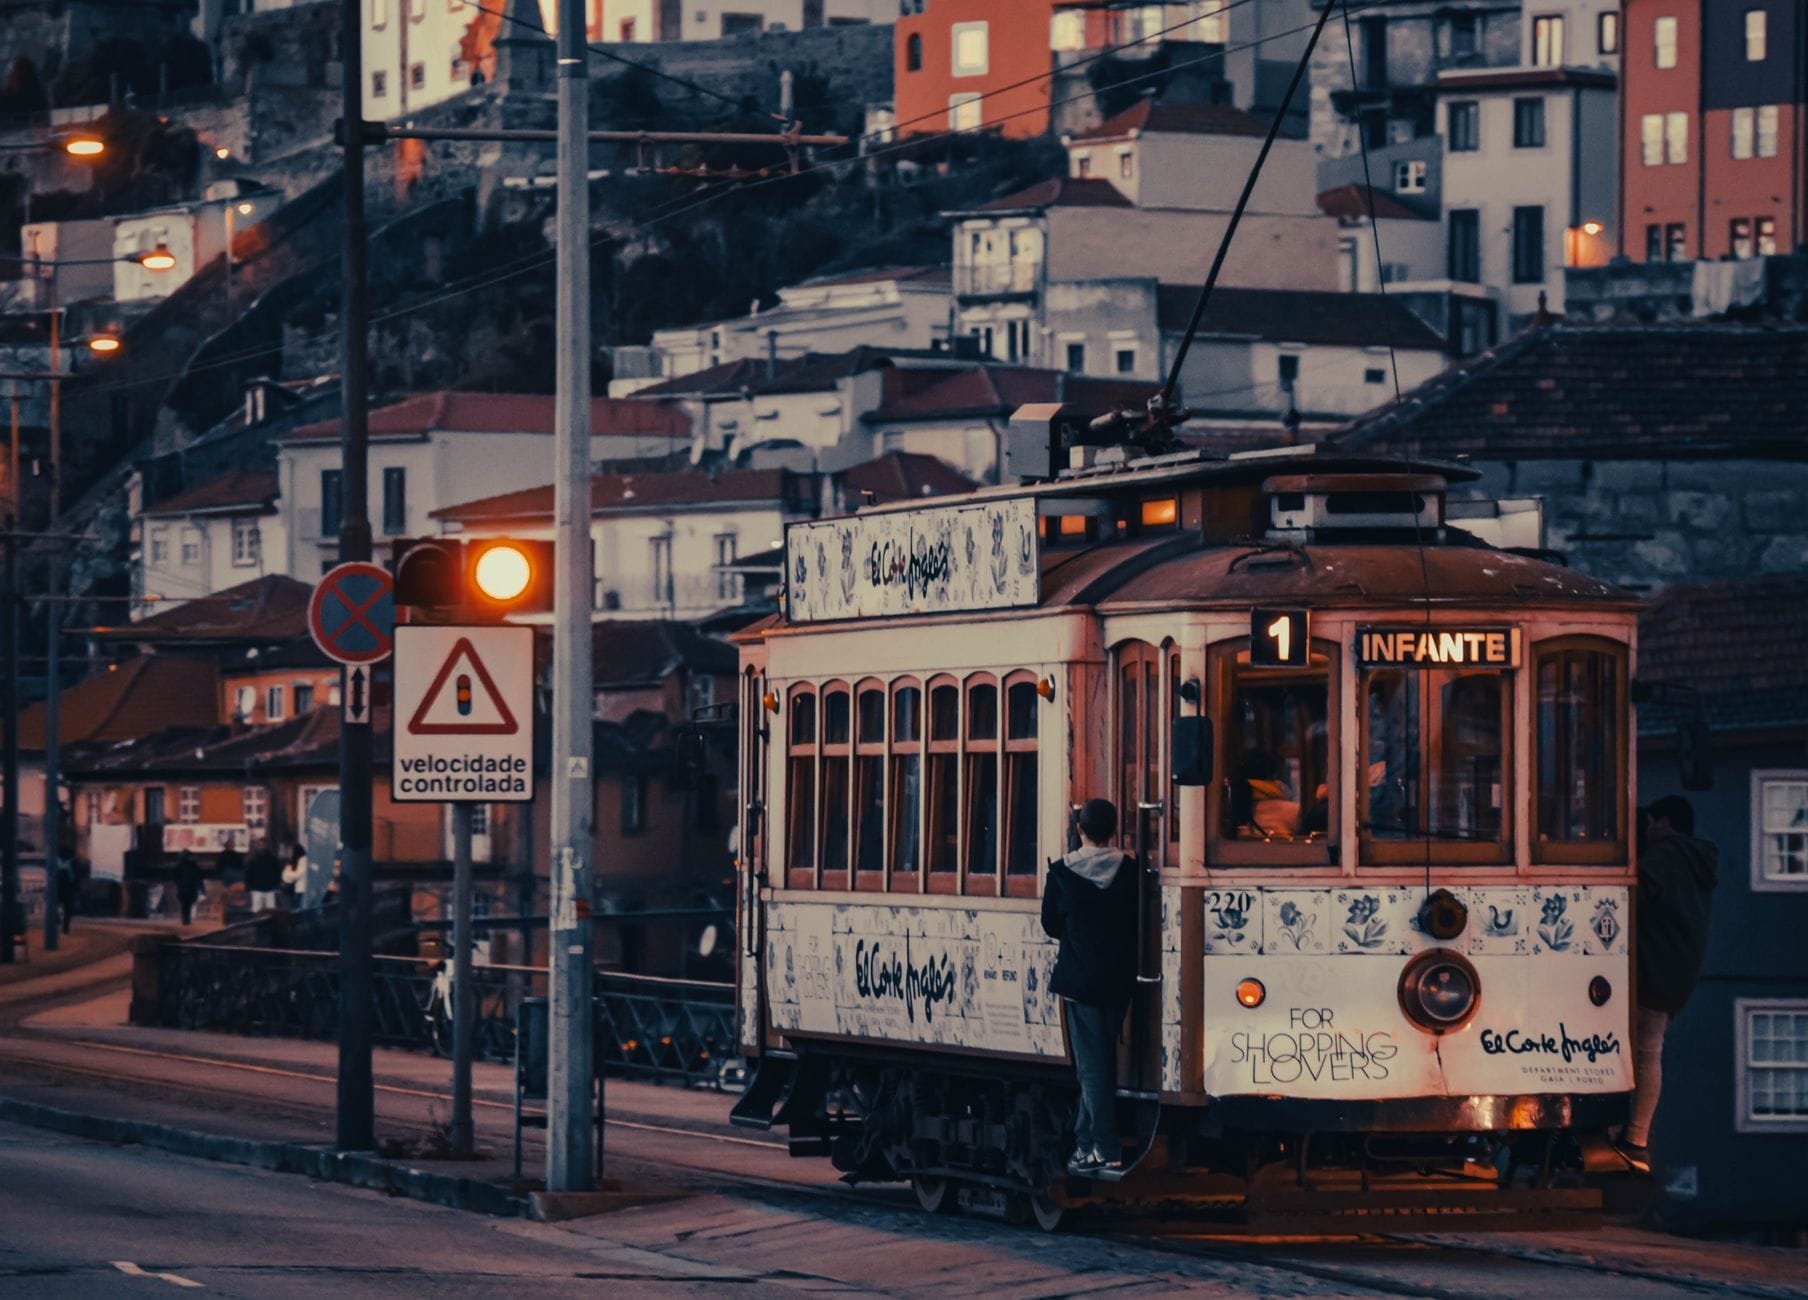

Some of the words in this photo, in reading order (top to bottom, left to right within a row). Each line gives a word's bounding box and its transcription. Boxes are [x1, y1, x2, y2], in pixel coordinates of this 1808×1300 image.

[1268, 616, 1290, 660] 1
[1362, 633, 1504, 662] INFANTE
[400, 754, 526, 773] velocidade
[400, 775, 525, 793] controlada
[1209, 891, 1251, 913] 220
[1290, 1008, 1334, 1029] FOR
[1230, 1032, 1398, 1063] SHOPPING
[1480, 1029, 1506, 1055] El
[1505, 1030, 1559, 1054] Corte
[1252, 1051, 1389, 1084] LOVERS
